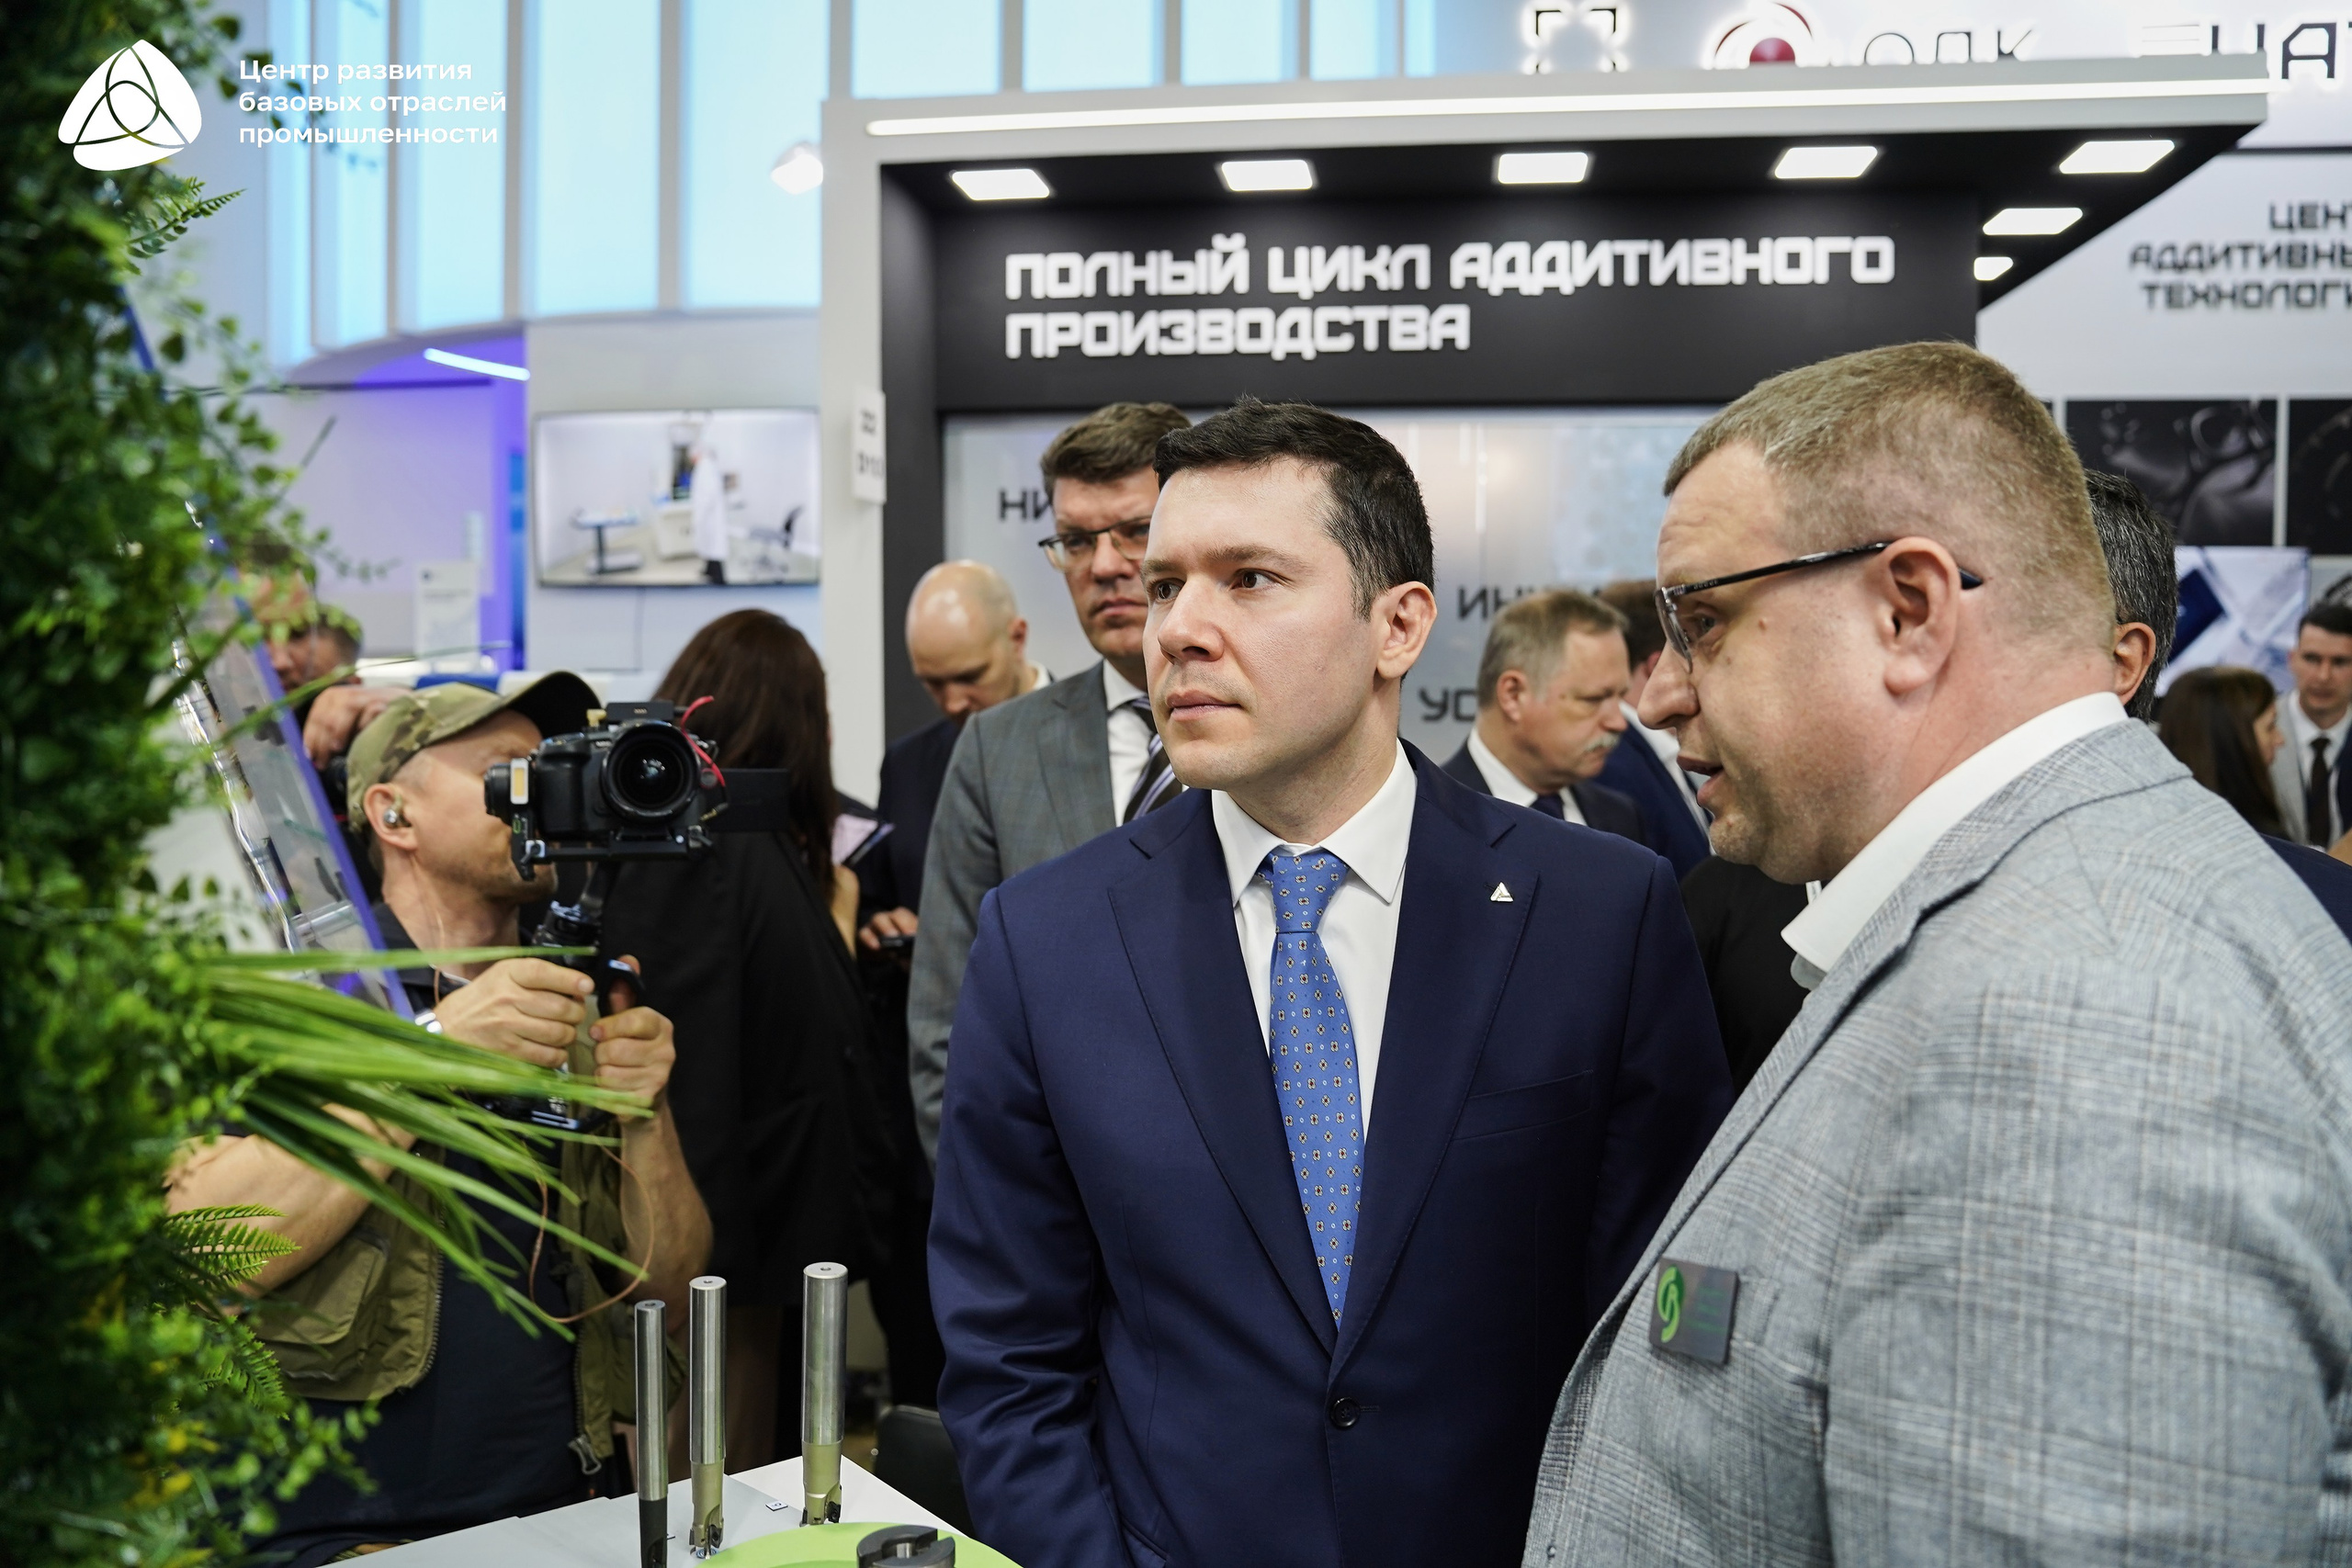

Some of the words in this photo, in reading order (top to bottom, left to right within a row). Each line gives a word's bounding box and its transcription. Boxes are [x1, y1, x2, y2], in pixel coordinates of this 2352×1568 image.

[2269, 203, 2352, 232] ЦЕН
[1005, 232, 1250, 299] ПОЛНЫЙ
[1268, 244, 1430, 300] ЦИКЛ
[1450, 235, 1895, 297] АДДИТИВНОГО
[1005, 304, 1470, 361] ПРОИЗВОДСТВА
[999, 490, 1050, 521] НИ
